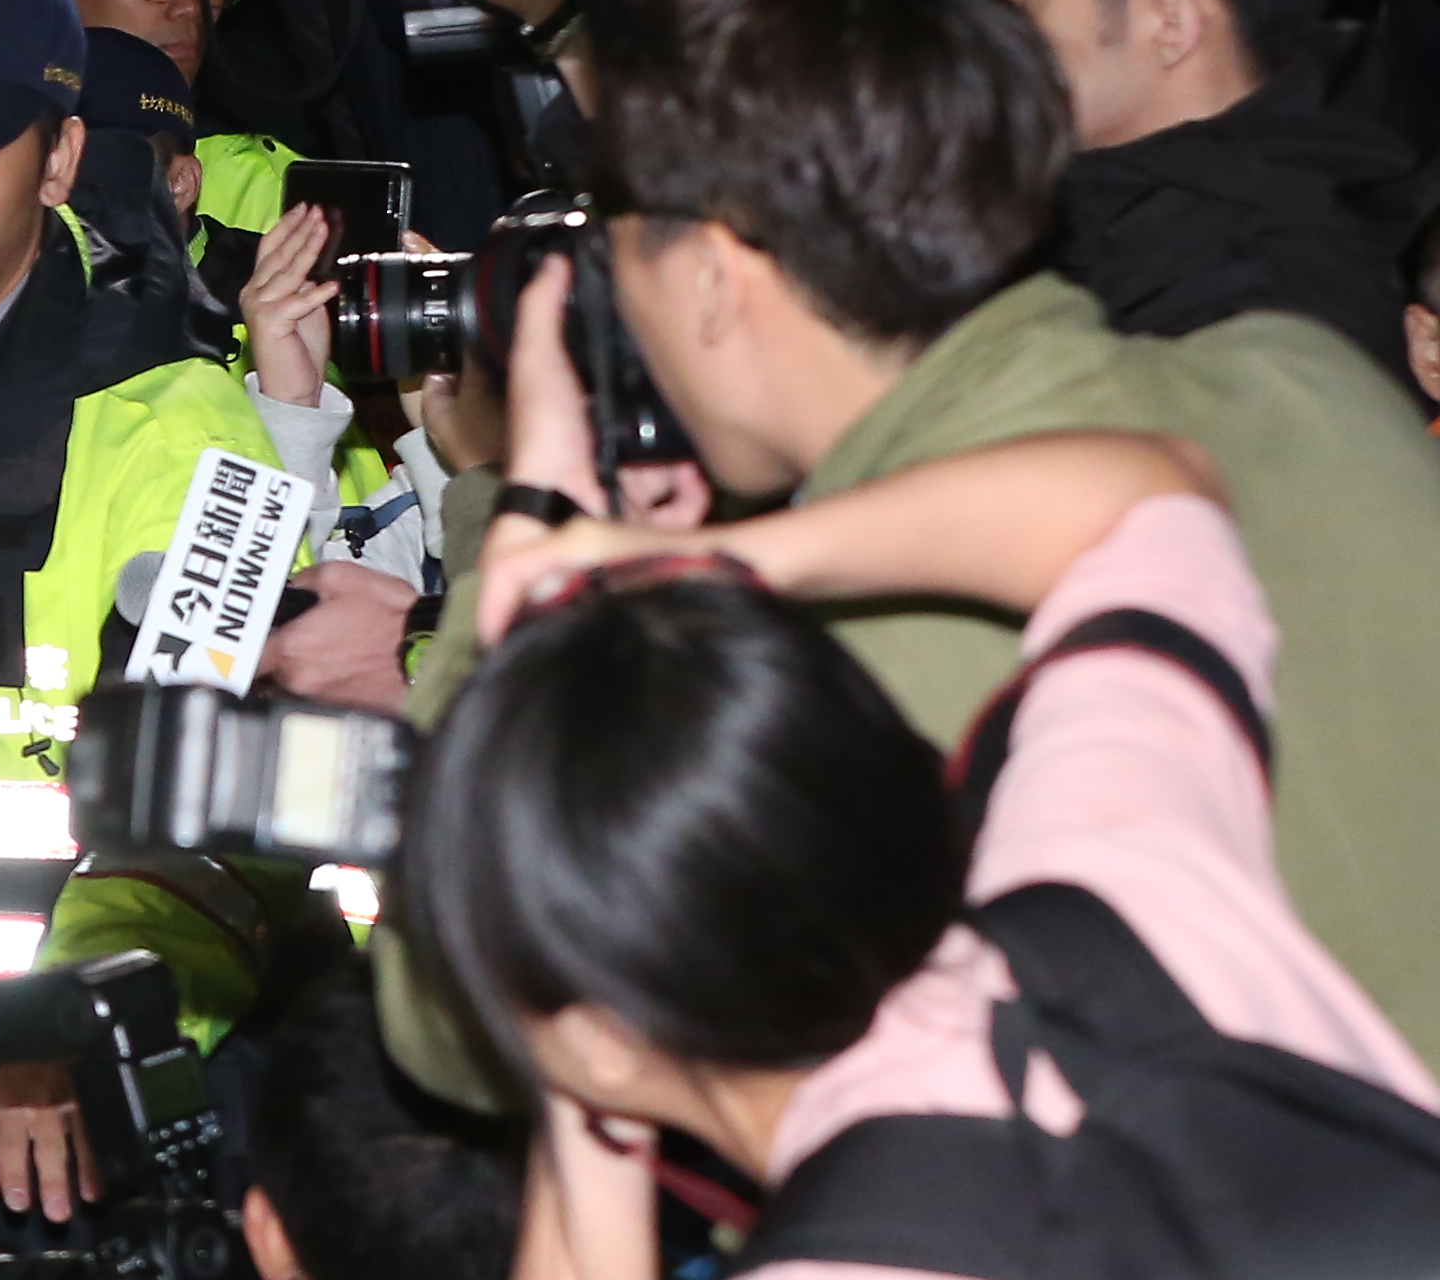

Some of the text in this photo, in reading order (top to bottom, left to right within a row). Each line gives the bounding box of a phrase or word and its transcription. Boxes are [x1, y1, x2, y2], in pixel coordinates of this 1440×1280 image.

[169, 457, 257, 625] 今日新聞
[212, 477, 292, 643] NOWNEWS
